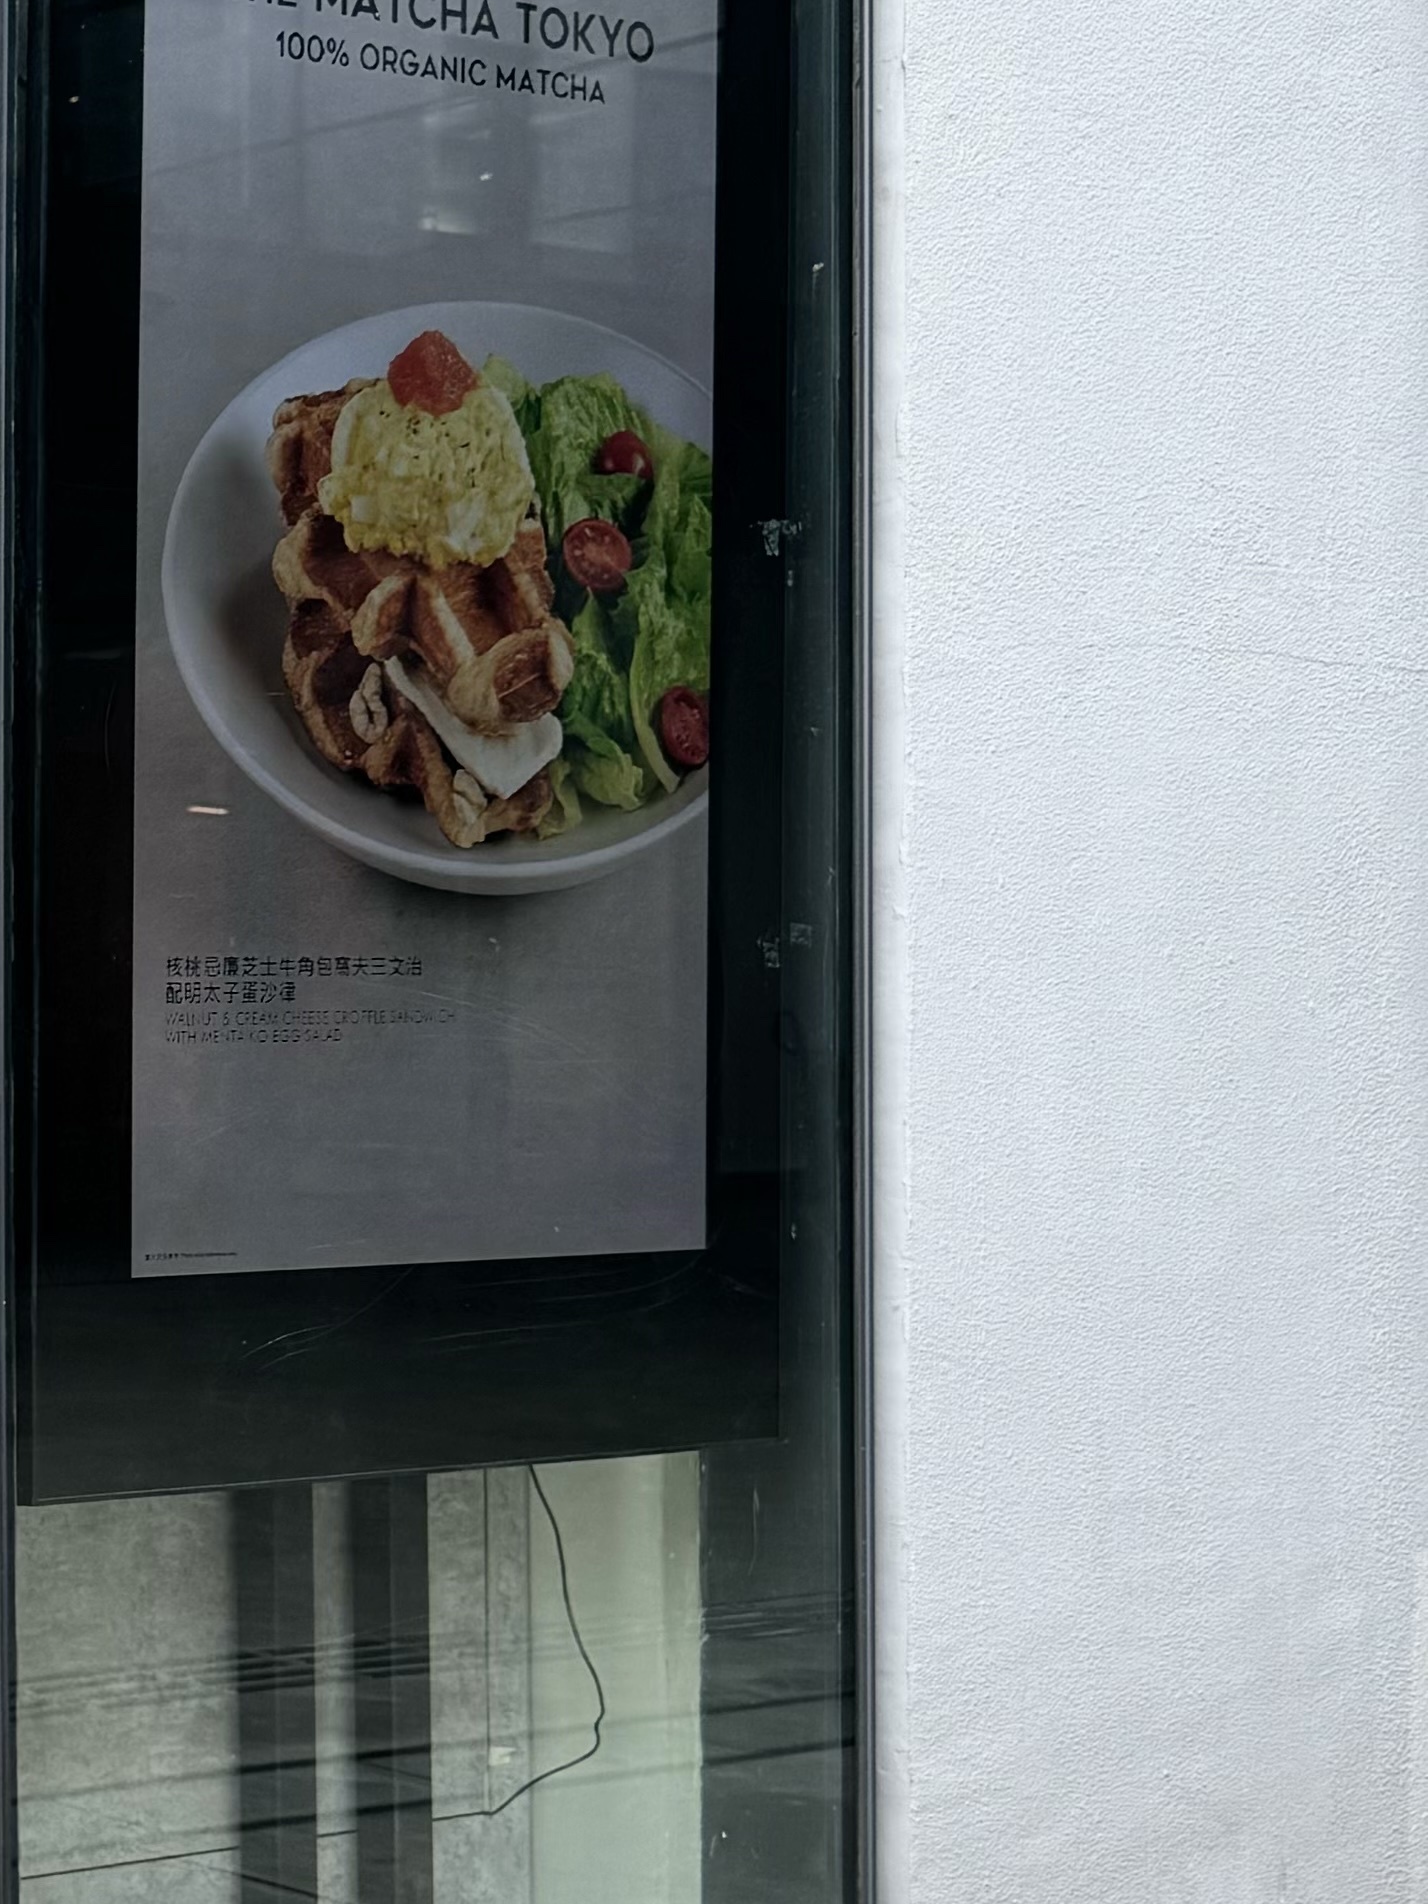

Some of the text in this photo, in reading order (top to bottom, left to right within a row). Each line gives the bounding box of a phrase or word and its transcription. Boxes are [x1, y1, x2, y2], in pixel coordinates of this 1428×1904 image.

[516, 2, 654, 63] TOKYO
[276, 30, 605, 104] 100% ORGANIC MATCHA
[390, 1009, 457, 1024] SANDWCH
[201, 1029, 268, 1043] MENTAKO
